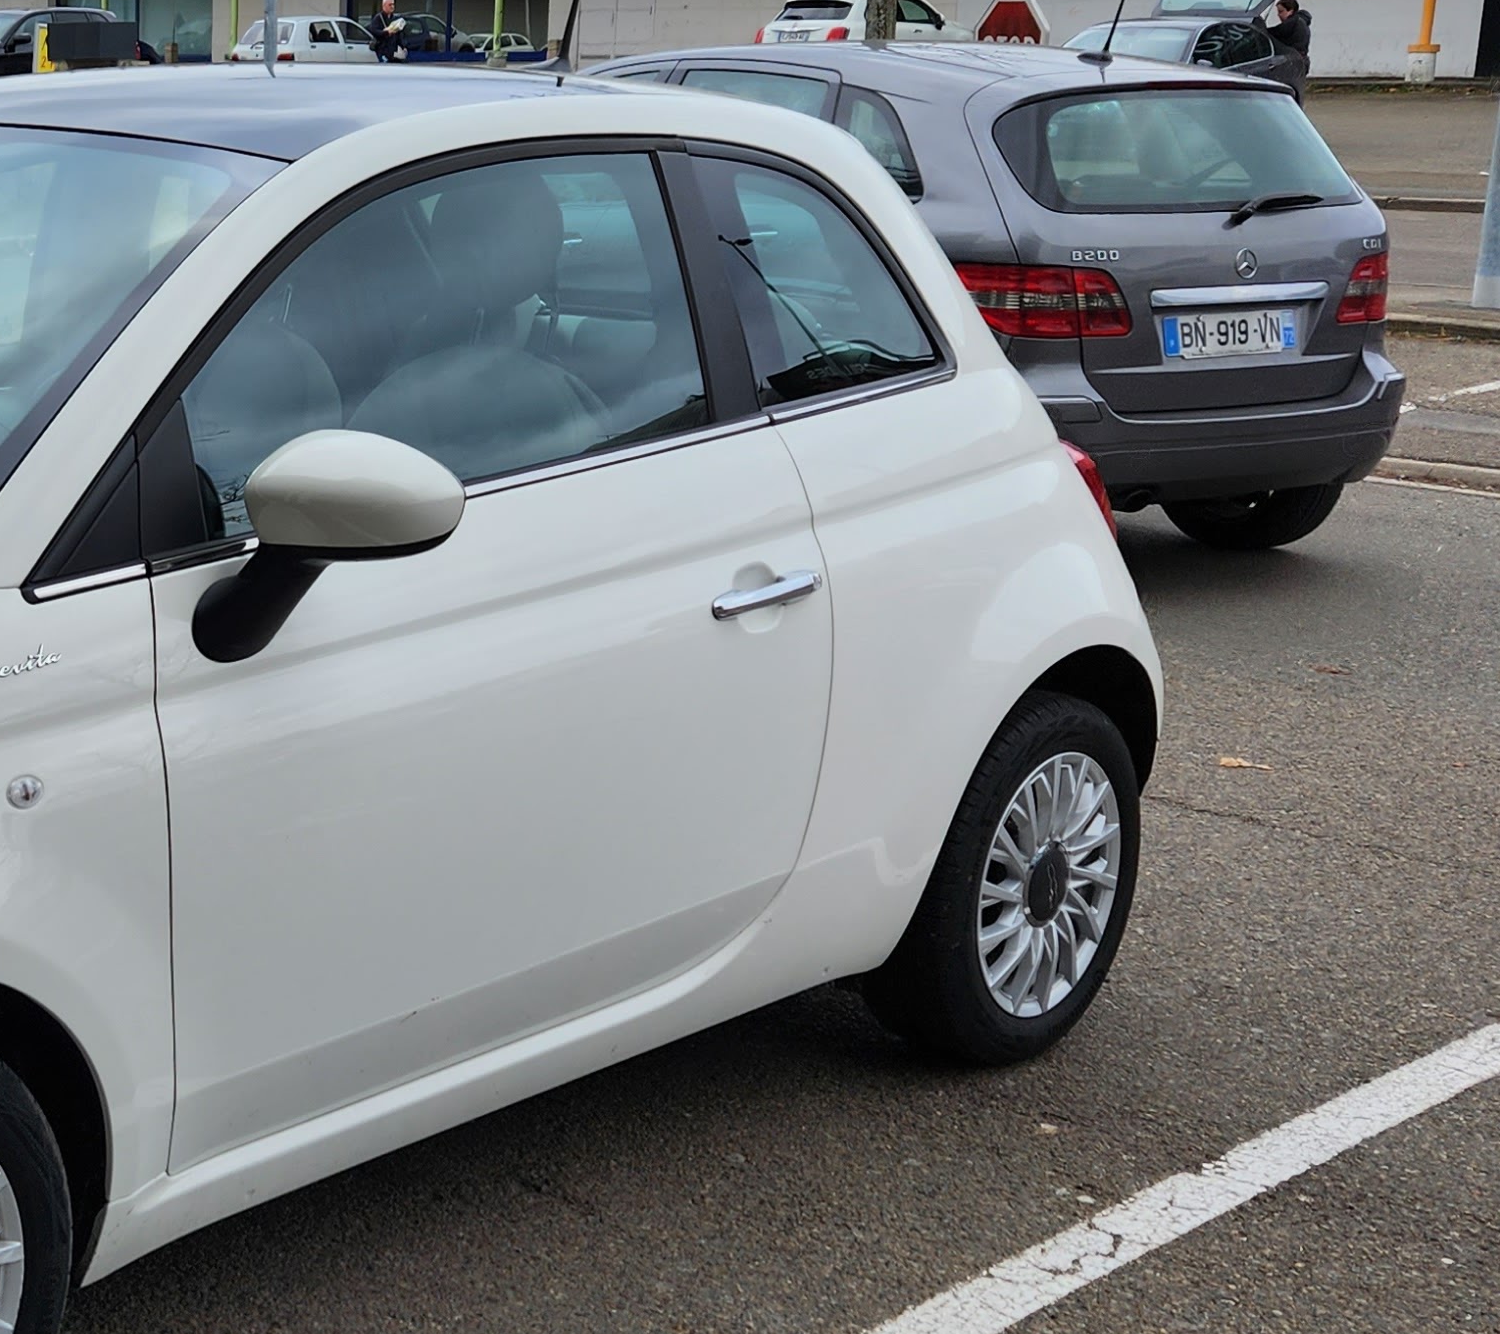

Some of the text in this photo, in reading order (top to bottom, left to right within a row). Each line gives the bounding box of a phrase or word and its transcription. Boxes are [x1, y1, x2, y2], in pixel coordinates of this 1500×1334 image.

[1072, 238, 1382, 261] B200 CDI
[1180, 317, 1295, 349] BN-919-VN 72
